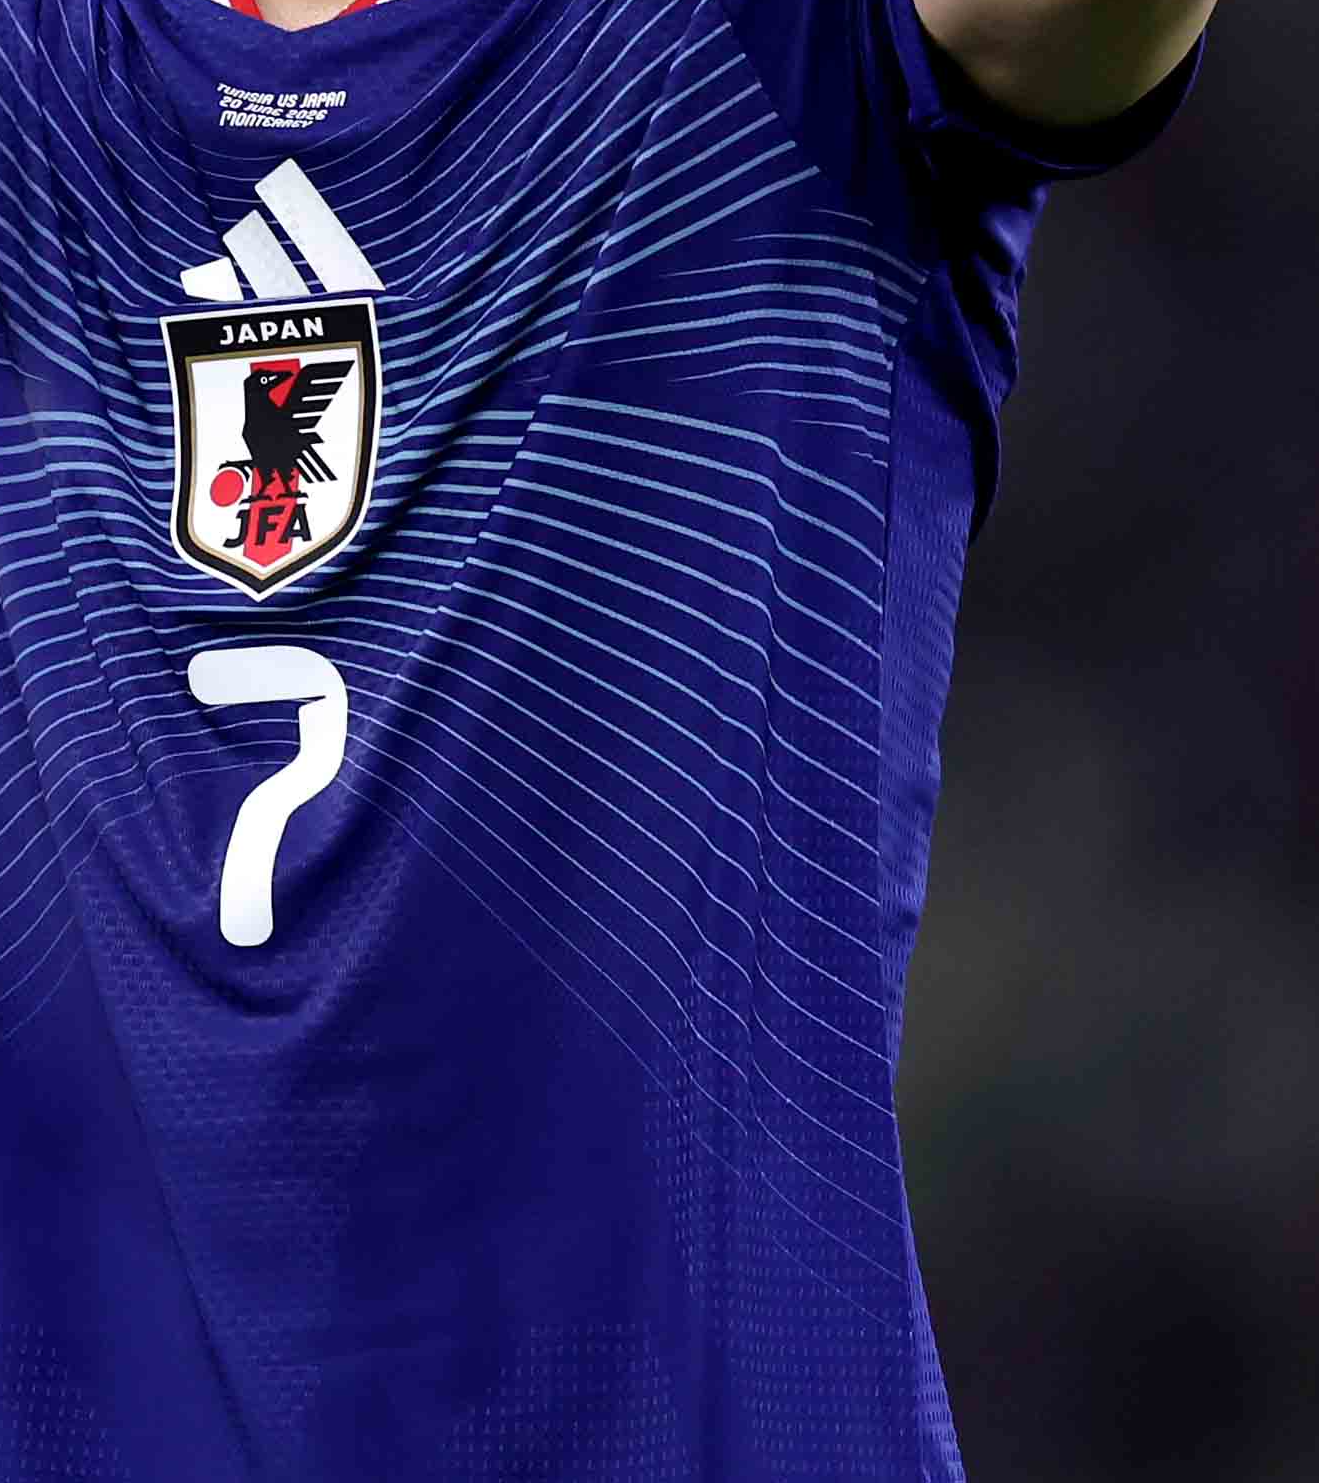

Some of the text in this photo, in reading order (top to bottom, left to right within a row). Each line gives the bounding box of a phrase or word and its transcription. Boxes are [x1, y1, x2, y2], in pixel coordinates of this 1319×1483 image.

[217, 83, 274, 105] TUNISIA
[299, 91, 346, 108] JAPAN
[219, 96, 328, 121] 20 JUNE 2026
[219, 110, 313, 128] MONTERREY
[220, 317, 324, 345] JAPAN
[223, 503, 312, 548] JFA
[187, 645, 348, 947] 7
